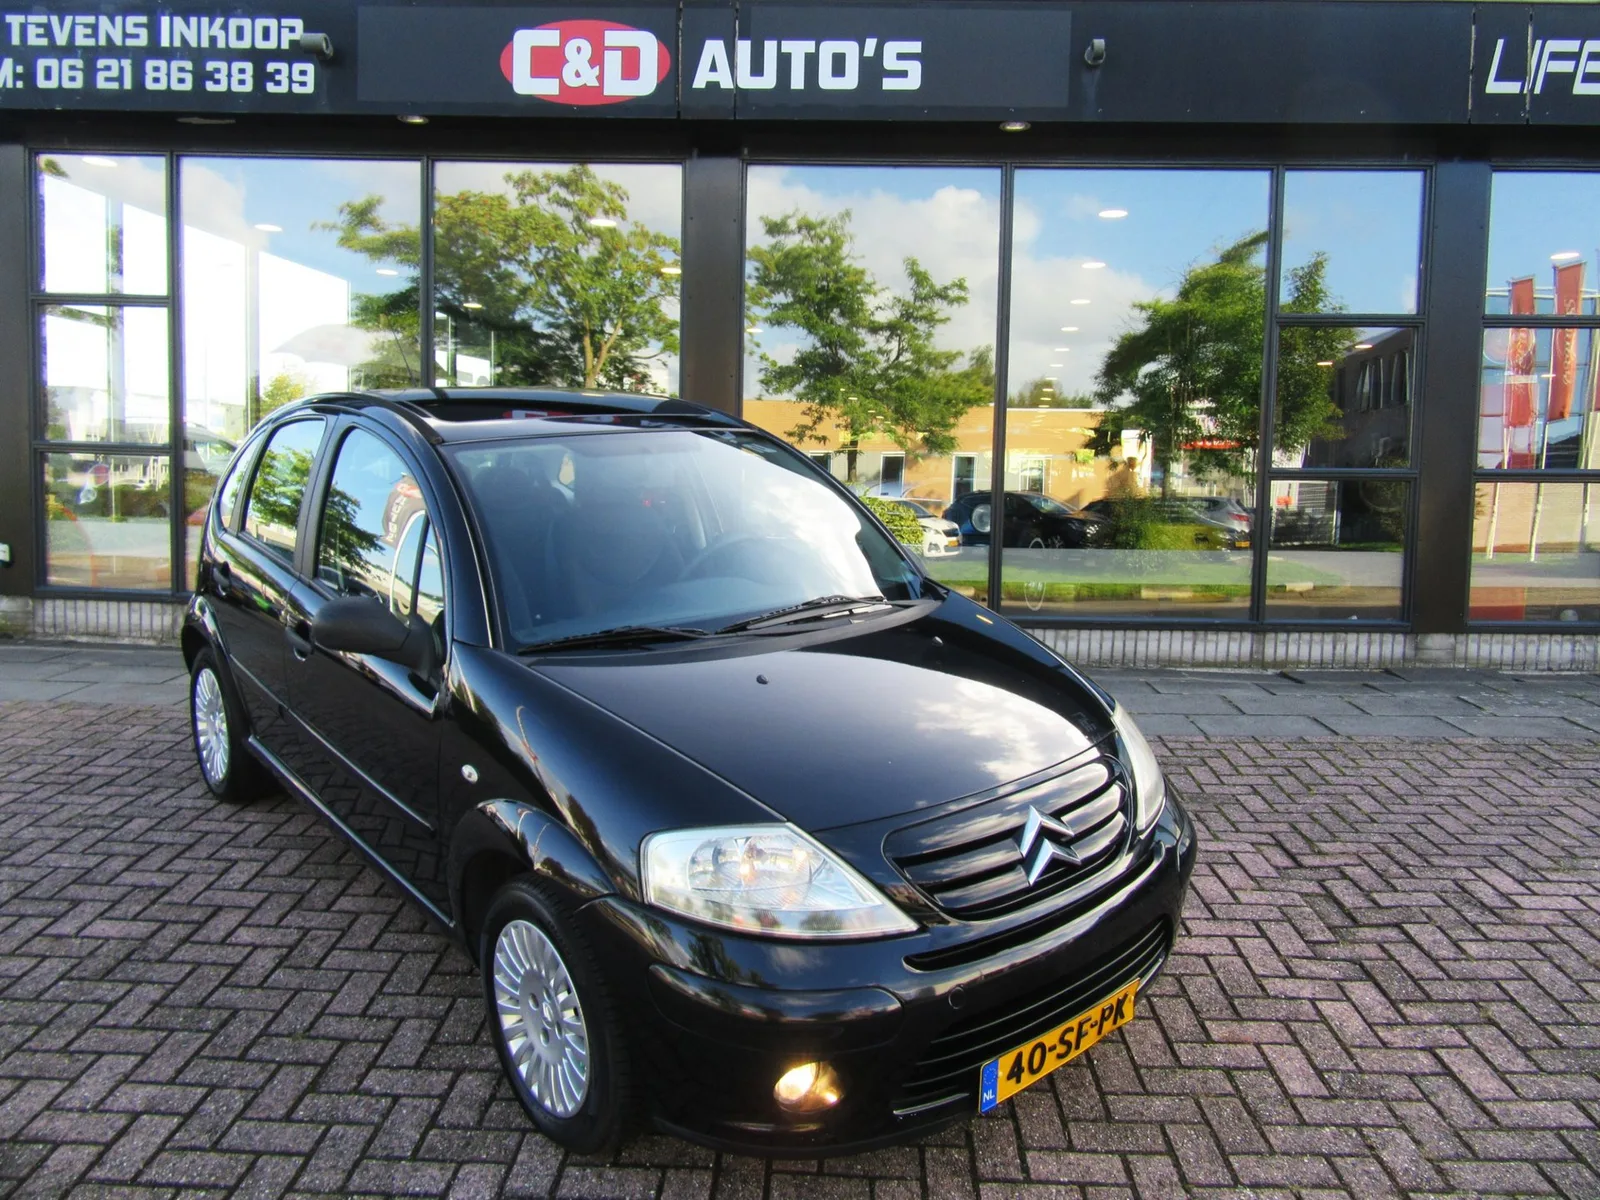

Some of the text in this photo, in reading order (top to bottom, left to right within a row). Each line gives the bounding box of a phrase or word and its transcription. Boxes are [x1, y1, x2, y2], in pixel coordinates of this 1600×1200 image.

[5, 14, 304, 50] TEVENS INKOOP
[36, 58, 84, 89] 06
[96, 58, 132, 90] 21
[145, 60, 193, 91] 86
[205, 61, 253, 93] 38
[266, 62, 315, 94] 39
[512, 28, 658, 97] C&D
[692, 37, 922, 91] AUTO'S
[1006, 991, 1129, 1084] 40-SF-PK
[982, 1088, 996, 1103] NL
